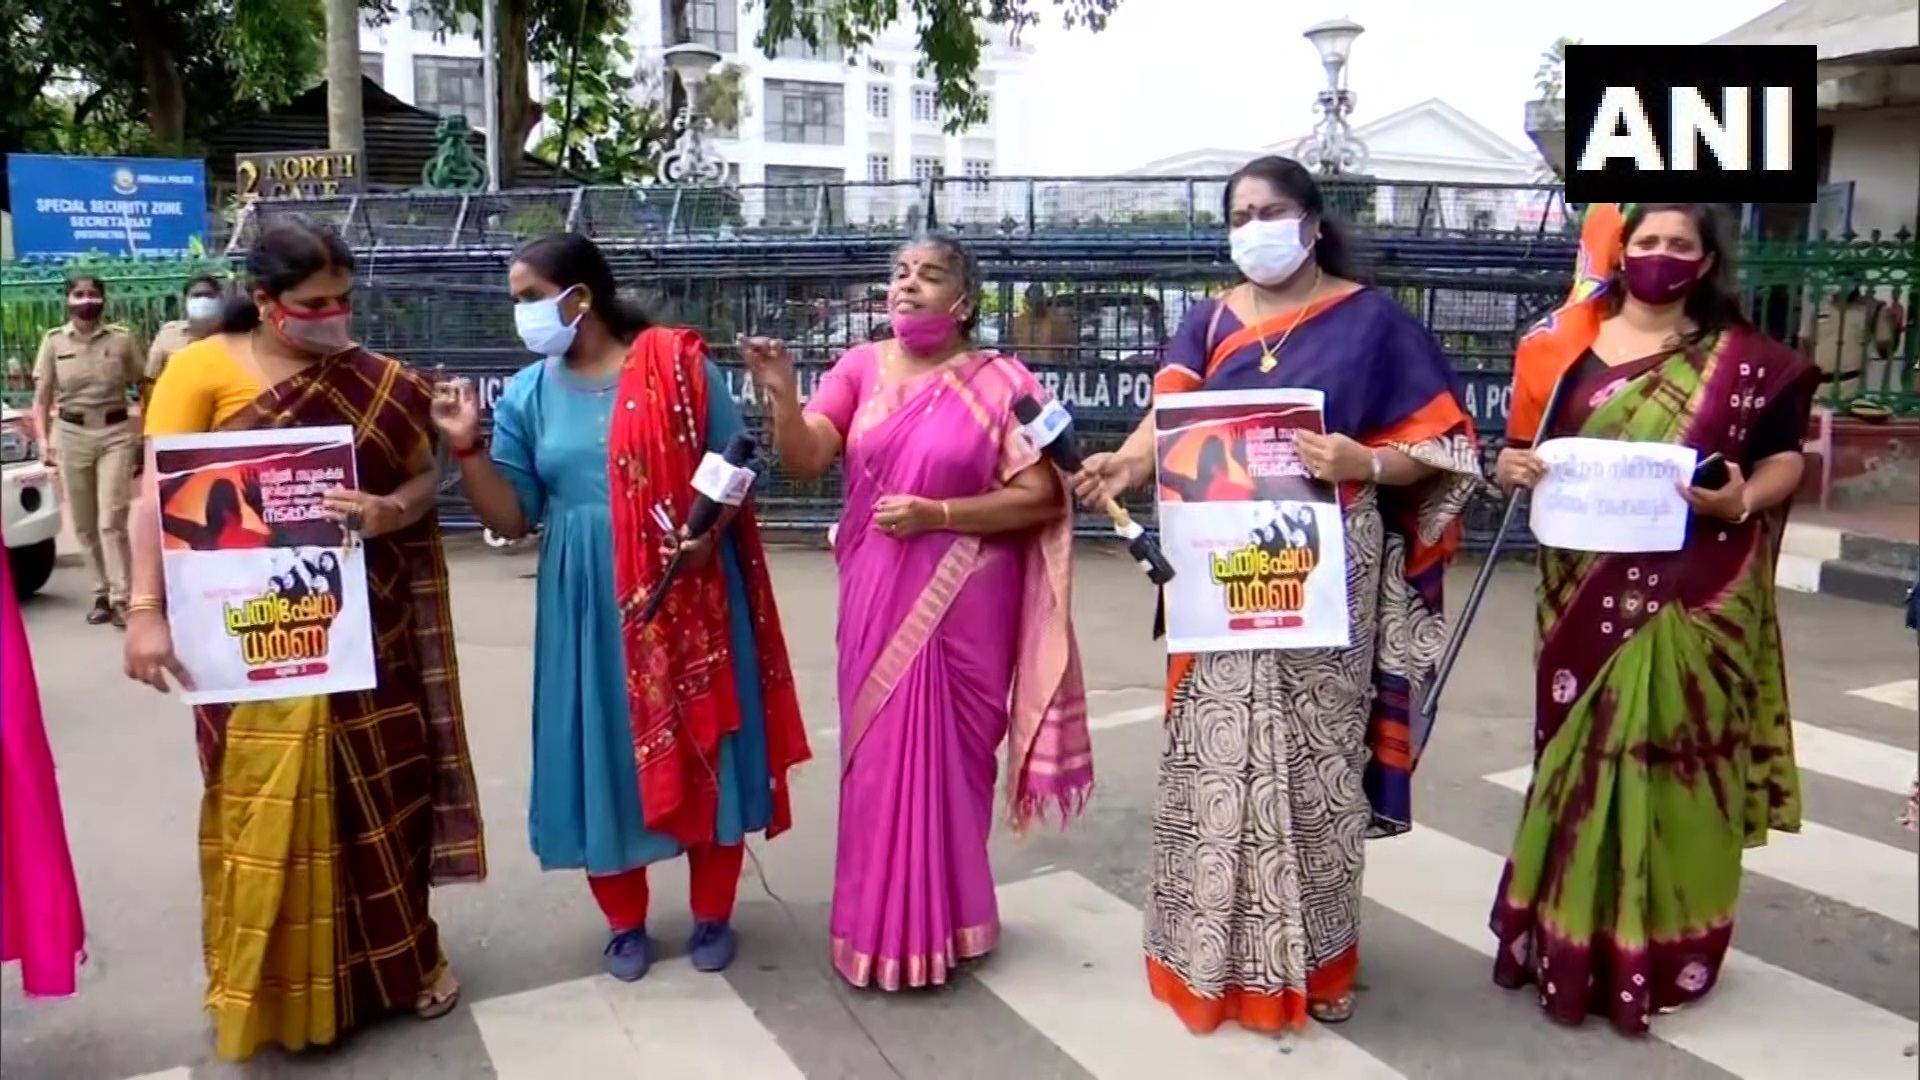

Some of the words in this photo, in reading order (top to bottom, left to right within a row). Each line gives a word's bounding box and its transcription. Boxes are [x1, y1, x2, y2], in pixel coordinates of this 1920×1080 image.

[266, 154, 354, 178] NORTH
[36, 198, 88, 214] SPECIAL
[90, 199, 149, 215] SECURITY
[151, 201, 183, 216] ZONE
[69, 215, 153, 228] SECRETARIAT
[1210, 544, 1314, 585] പ്രതിഷേധ
[224, 591, 337, 636] പ്രതിഷേധ
